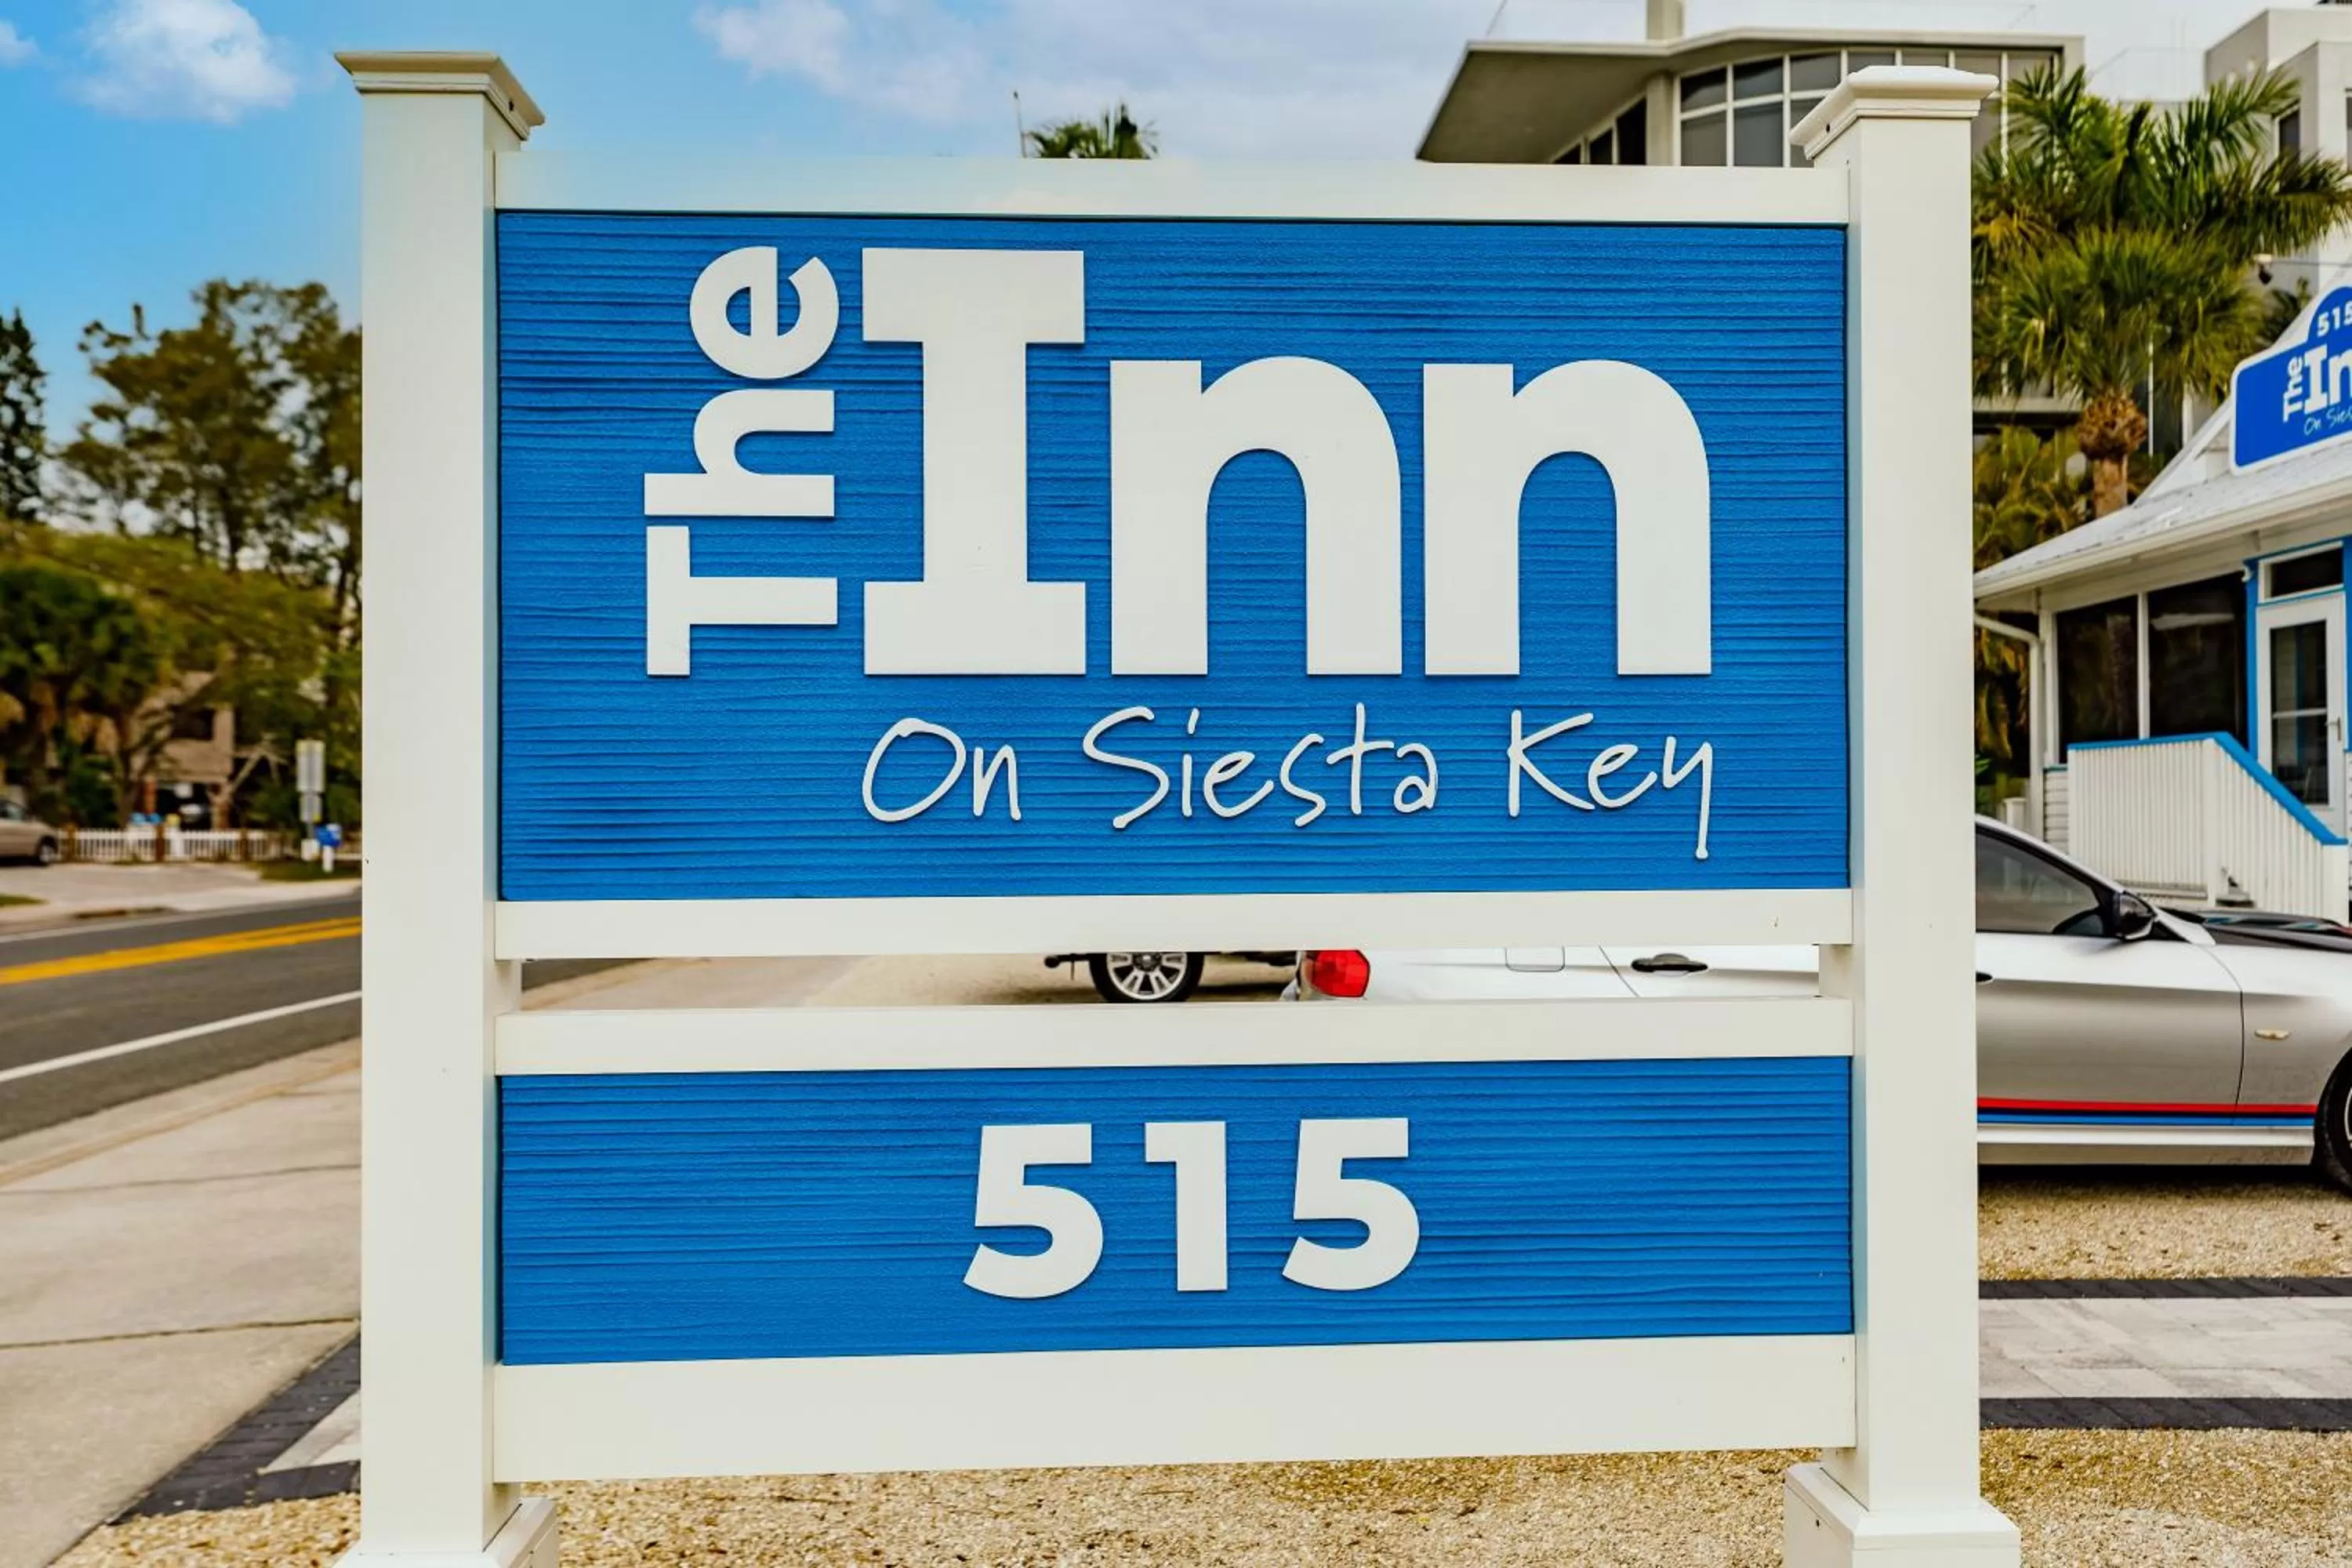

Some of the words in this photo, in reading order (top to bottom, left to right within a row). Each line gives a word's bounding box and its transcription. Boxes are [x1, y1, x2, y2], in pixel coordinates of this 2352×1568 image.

[644, 246, 839, 677] The
[861, 247, 1712, 677] Inn
[2282, 355, 2303, 423] The
[2303, 417, 2321, 436] On
[862, 717, 1022, 822] On
[1082, 702, 1439, 829] Siesta
[1507, 709, 1714, 860] Key
[963, 1117, 1420, 1299] 515
